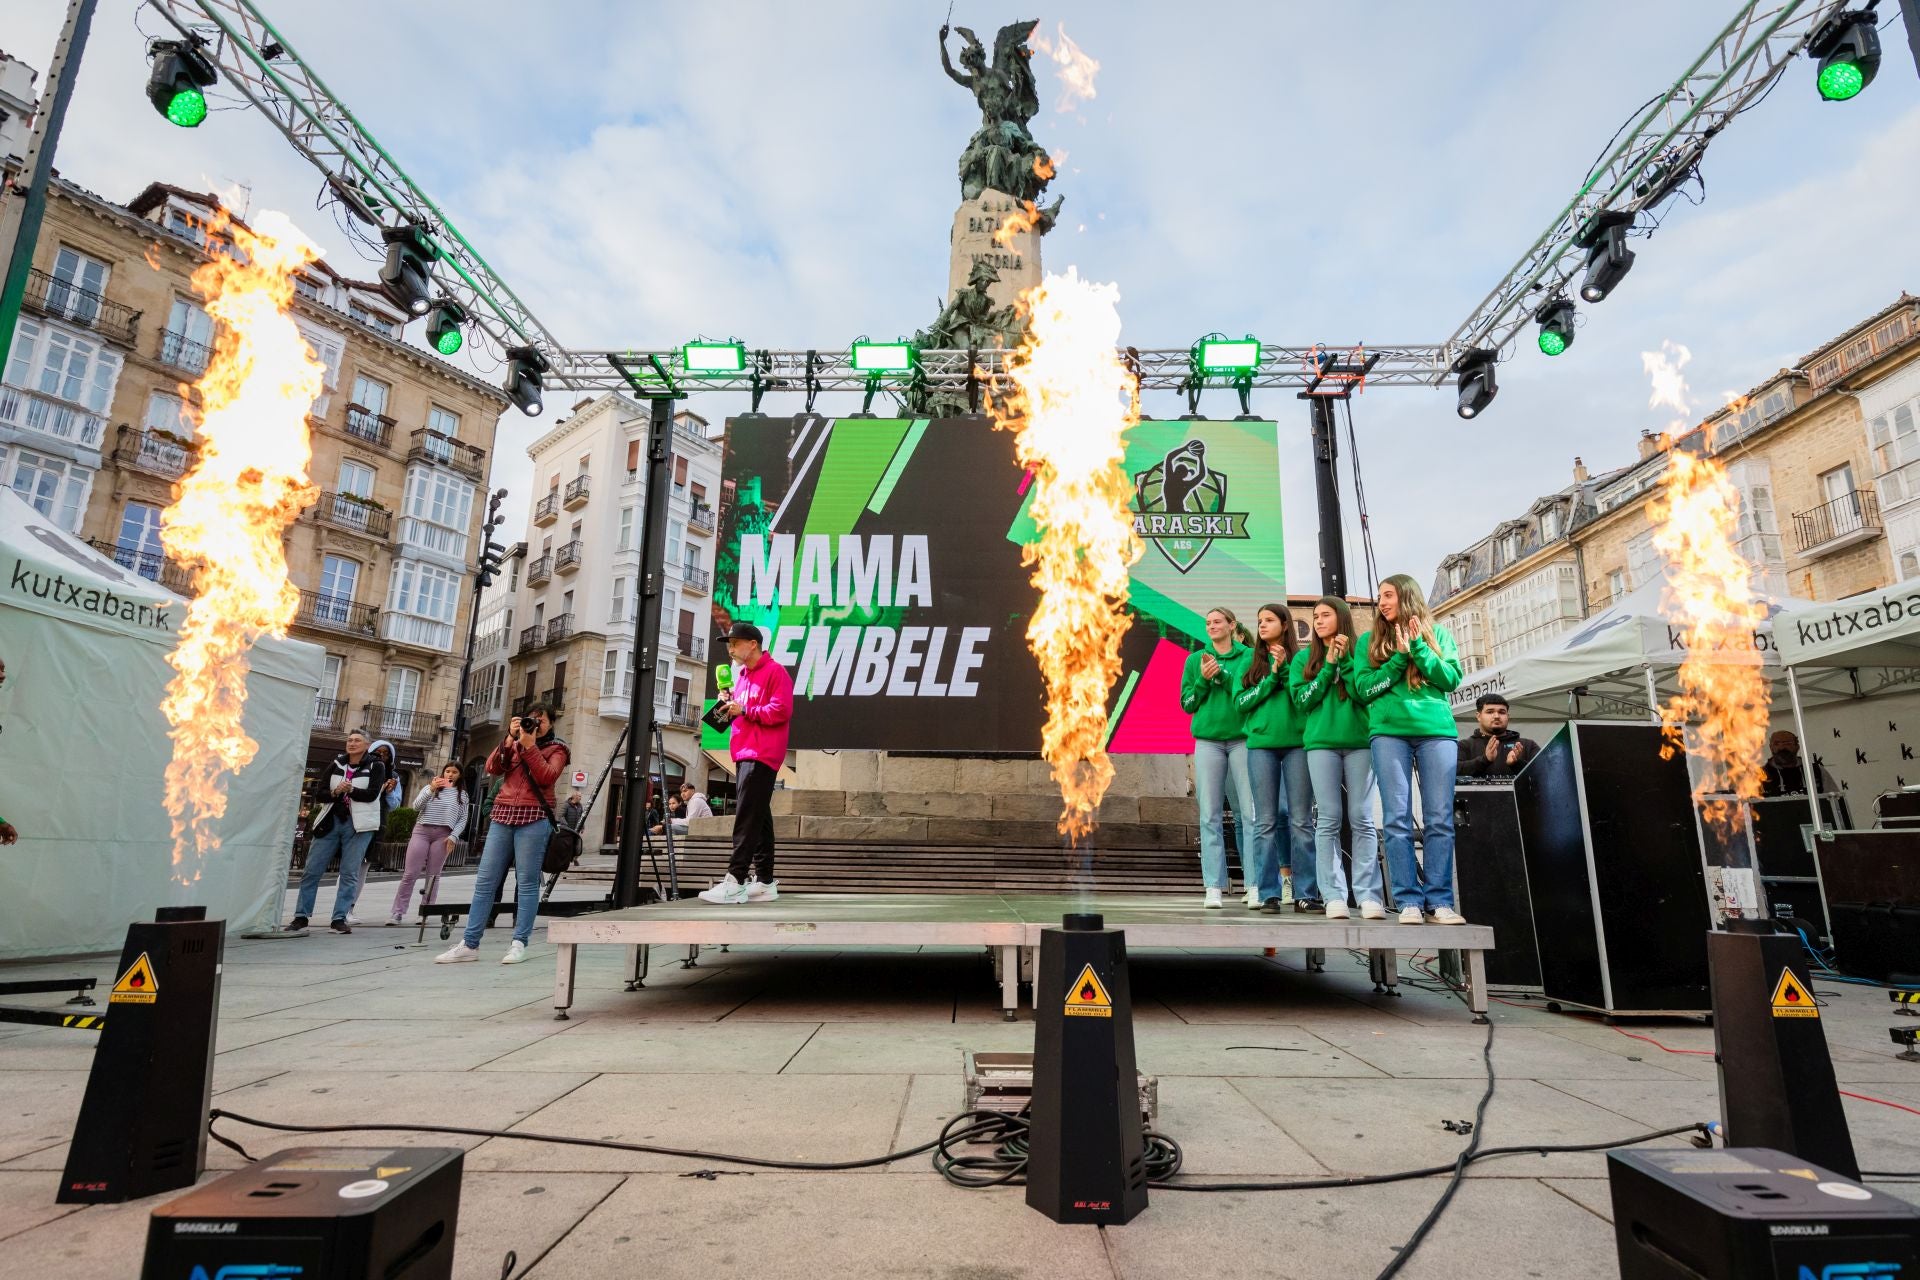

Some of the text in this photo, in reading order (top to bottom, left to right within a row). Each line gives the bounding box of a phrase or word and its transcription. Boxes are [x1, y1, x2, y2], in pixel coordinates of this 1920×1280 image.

[1133, 516, 1233, 535] ARASKI
[1173, 541, 1192, 549] AES
[10, 559, 169, 630] kutxabank
[736, 533, 933, 607] MAMA
[728, 625, 991, 697] EMBELE
